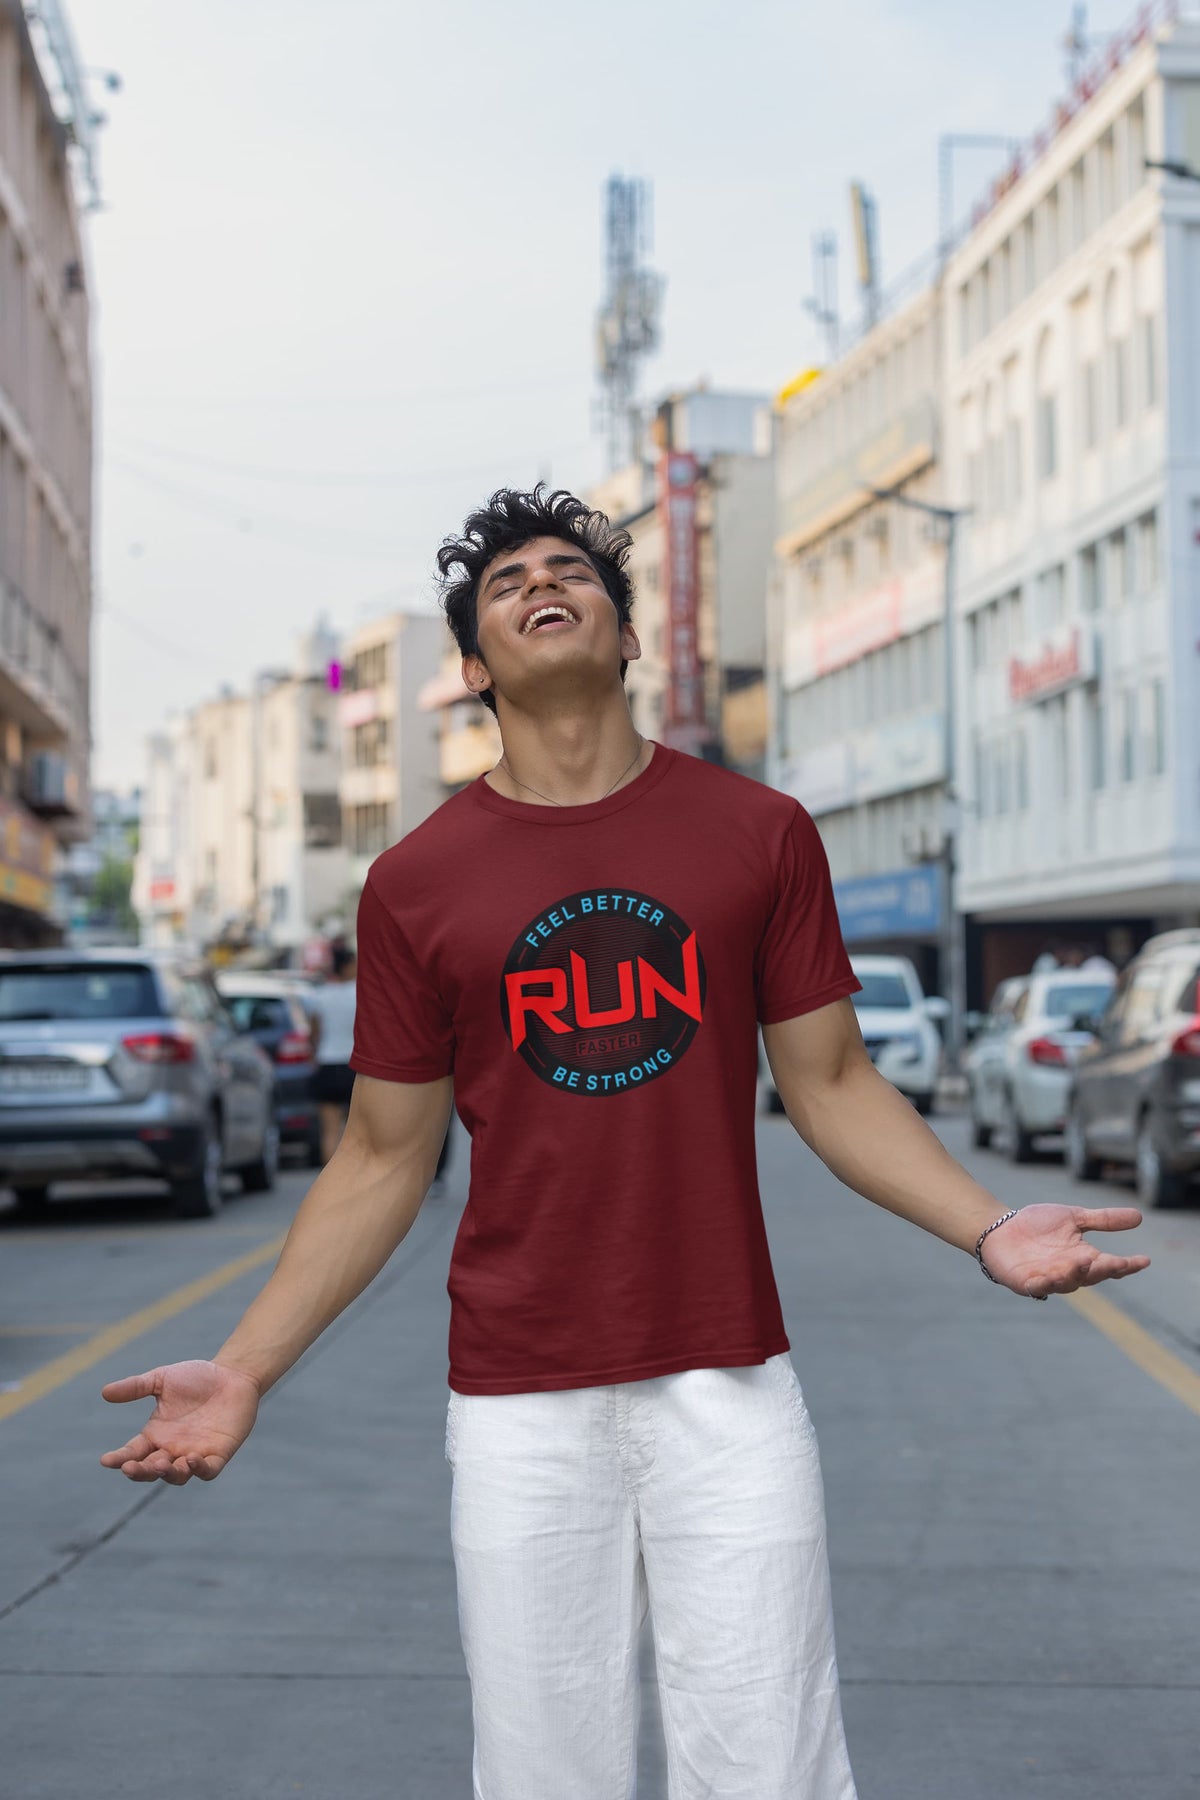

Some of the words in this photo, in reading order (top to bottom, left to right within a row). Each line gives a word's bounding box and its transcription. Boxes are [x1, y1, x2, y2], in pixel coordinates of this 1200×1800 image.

[525, 906, 575, 947] FEEL
[581, 895, 664, 926] BETTER
[504, 930, 702, 1052] RUN
[578, 1033, 638, 1055] FASTER
[552, 1066, 580, 1087] BE
[586, 1048, 672, 1090] STRONG
